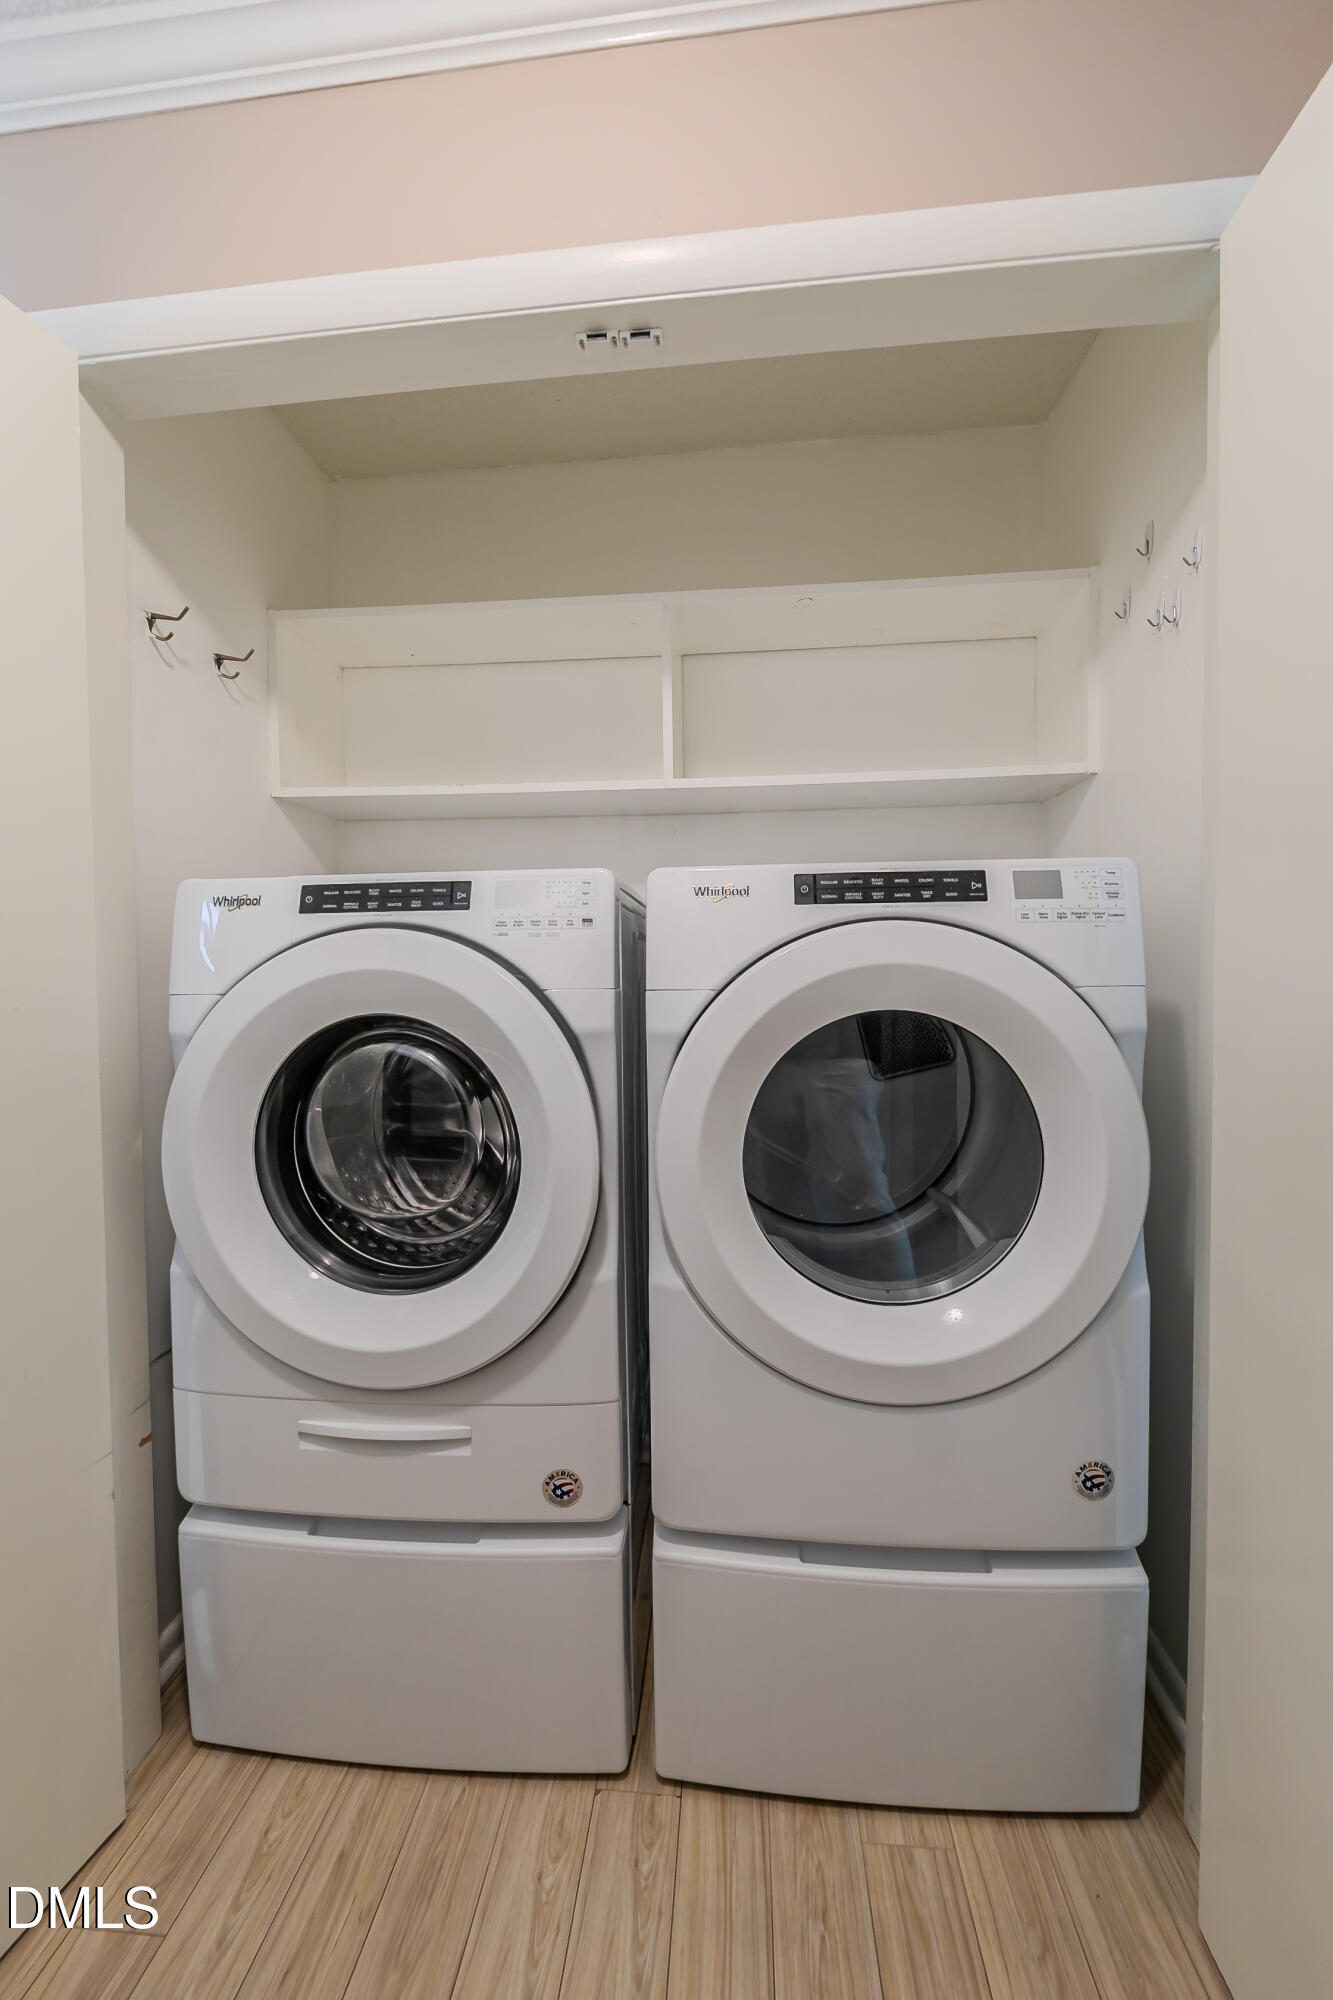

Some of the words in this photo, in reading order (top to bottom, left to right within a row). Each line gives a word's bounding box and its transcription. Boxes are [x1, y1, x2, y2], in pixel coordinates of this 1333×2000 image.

[693, 885, 750, 901] Whirlpool
[213, 895, 261, 910] Whirlpool
[1075, 1461, 1111, 1478] AMERICA
[545, 1471, 579, 1487] AMERICA
